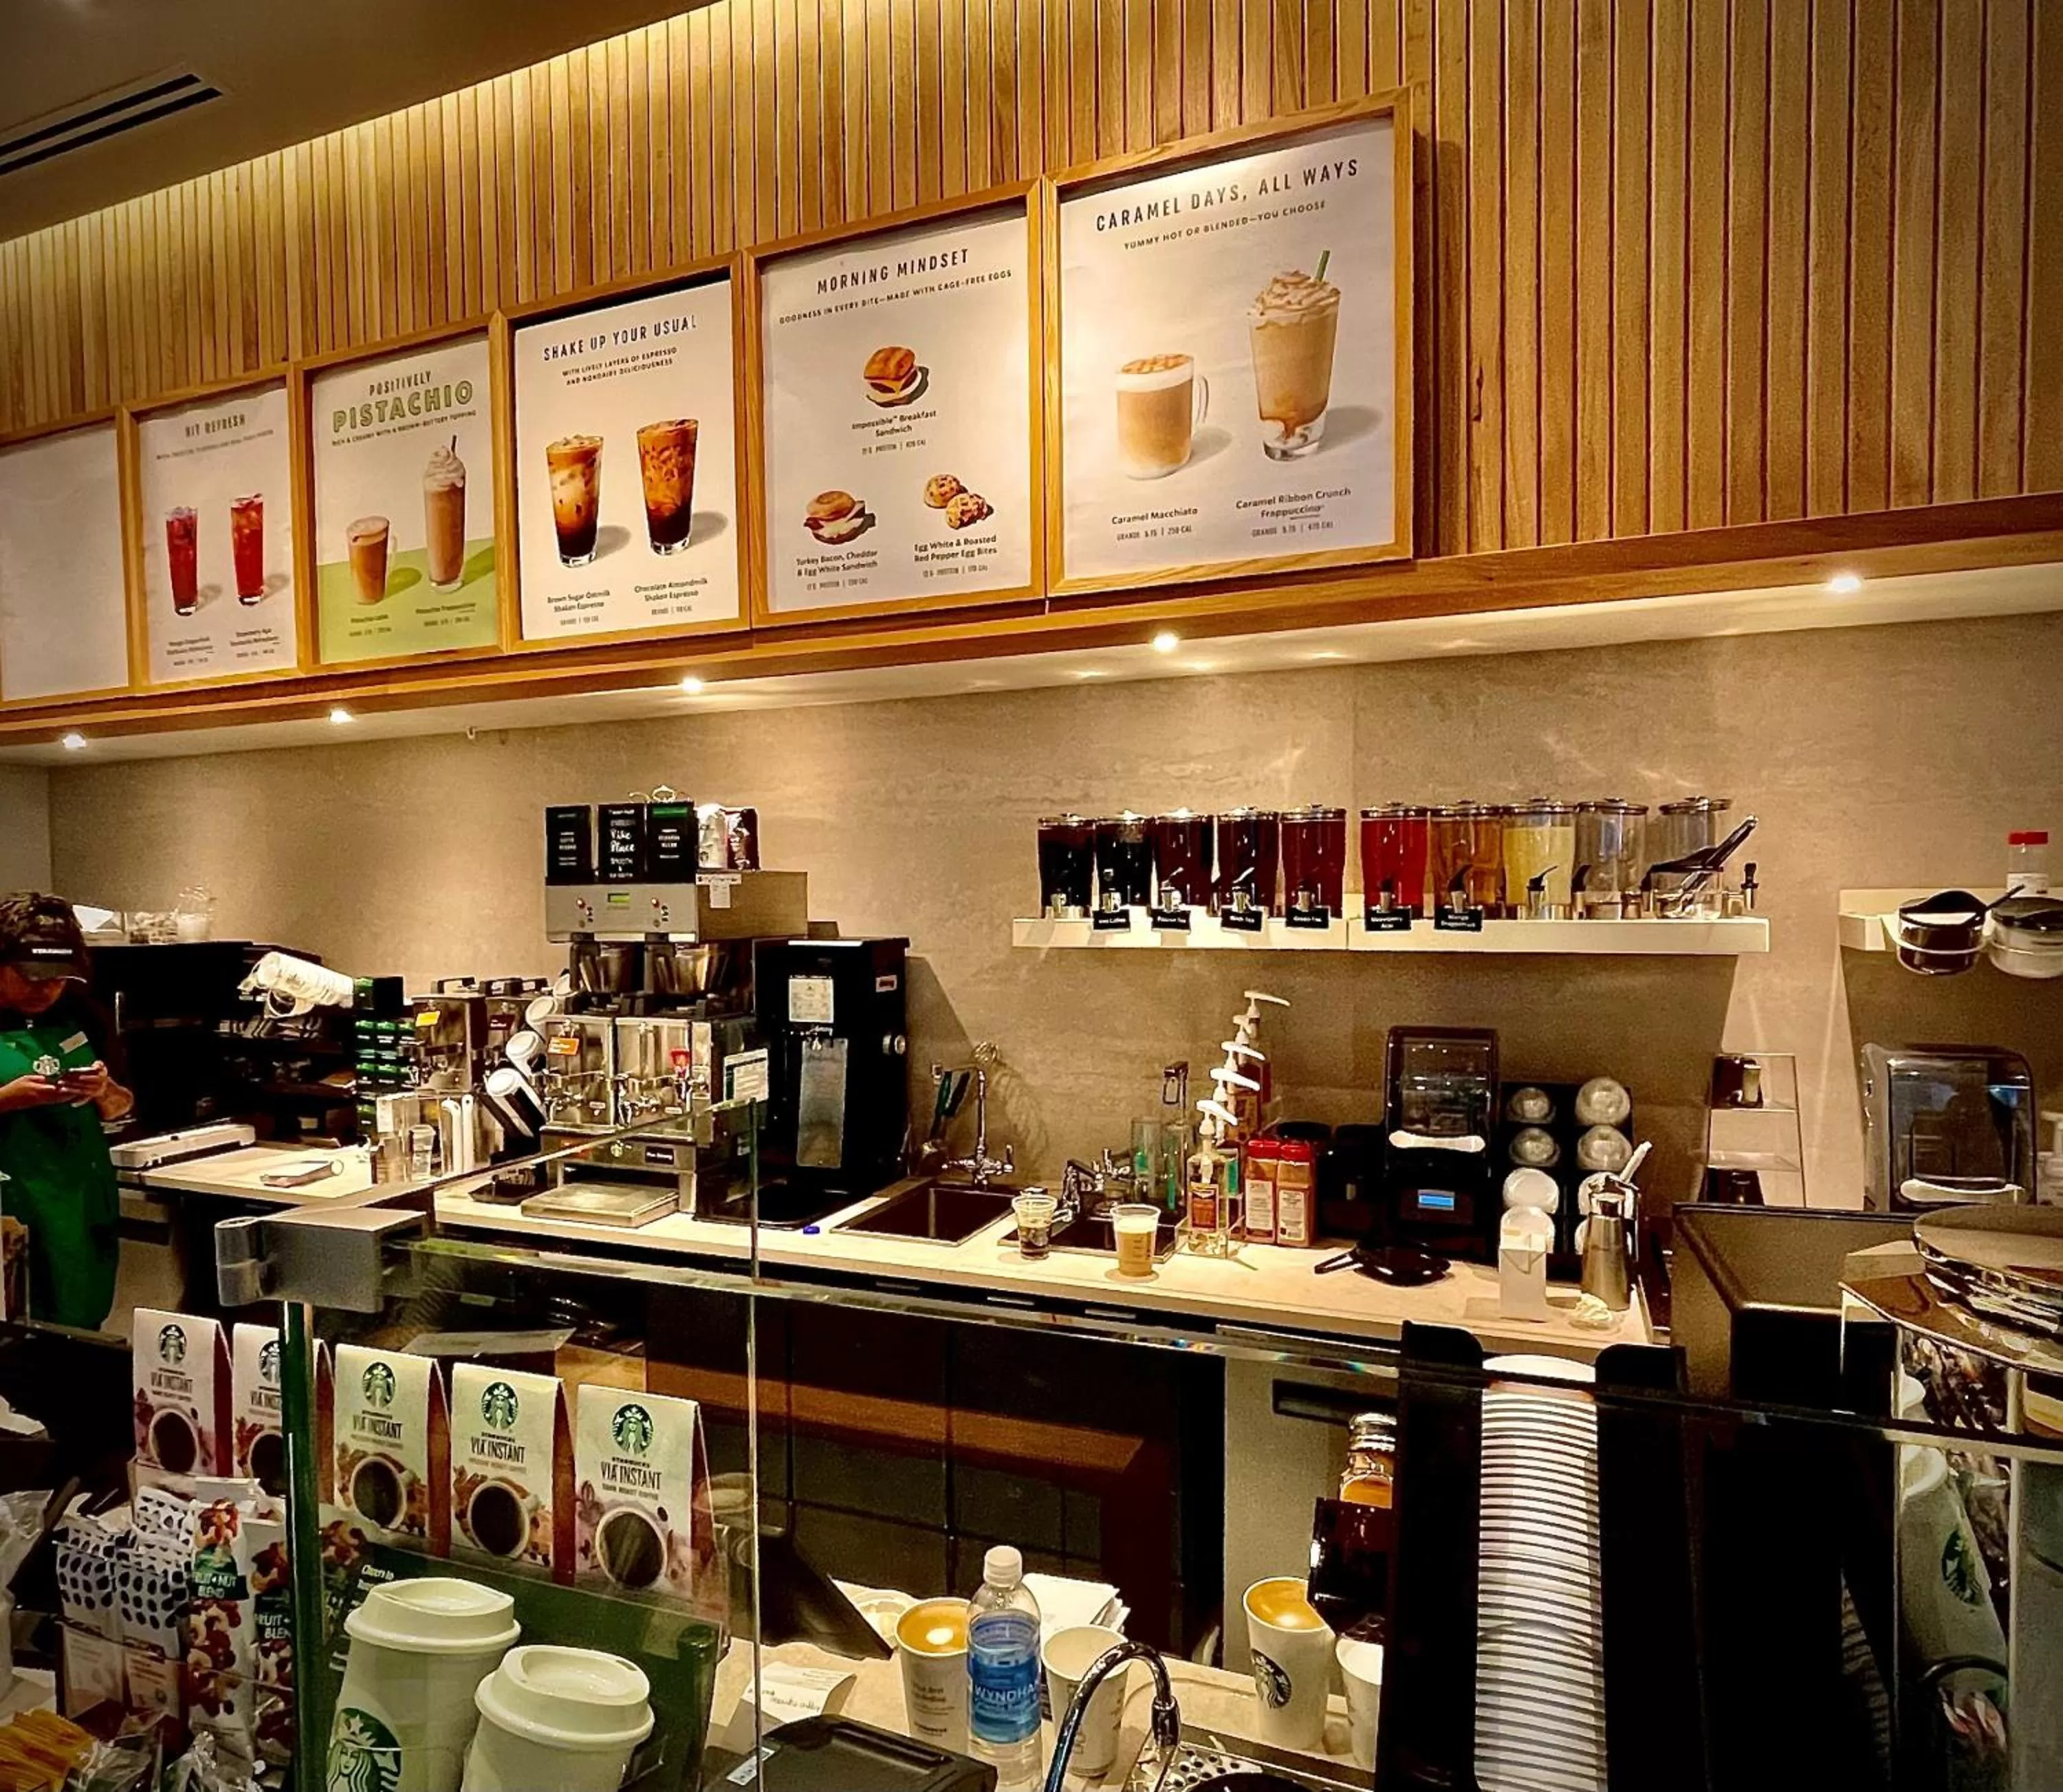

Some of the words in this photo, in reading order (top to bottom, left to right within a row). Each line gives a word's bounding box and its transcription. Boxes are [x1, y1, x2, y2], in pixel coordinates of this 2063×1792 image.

[1096, 197, 1181, 232] CARAMEL
[1191, 184, 1247, 210] DAYS,
[1259, 174, 1291, 196] ALL
[1303, 159, 1359, 186] WAYS
[1124, 237, 1160, 250] YUMMY
[1163, 230, 1183, 242] HOT
[1186, 226, 1200, 236] OR
[1282, 200, 1326, 217] CHOOSE
[817, 265, 889, 294] MORNING
[897, 248, 969, 278] MINDSET
[779, 309, 822, 325] GOODNESS
[834, 301, 859, 313] EVERY
[913, 285, 936, 297] WITH
[937, 275, 985, 292] CAGE-FREE
[988, 269, 1012, 281] EGGS
[544, 340, 584, 361] SHAKE
[590, 335, 606, 351] UP
[613, 326, 646, 345] YOUR
[654, 315, 697, 337] USUAL
[562, 367, 580, 377] WITH
[581, 363, 603, 373] LIVELY
[604, 358, 629, 369] LAYERS
[642, 347, 677, 360] ESPRESSO
[620, 358, 673, 375] DELICIOUSNESS
[369, 371, 431, 396] POSITIVELY
[333, 380, 473, 433] PISTACHIO
[899, 411, 936, 422] Breakfast
[185, 424, 200, 437] HIT
[204, 414, 245, 434] REFRESH
[875, 424, 913, 437] Sandwich
[1236, 496, 1276, 510] Caramel
[1278, 493, 1313, 506] Ribbon
[1316, 487, 1351, 500] Crunch
[1112, 513, 1149, 525] Caramel
[1151, 506, 1198, 520] Macchiato
[914, 554, 929, 562] Red
[930, 552, 959, 561] Pepper
[961, 549, 975, 558] Egg
[977, 547, 998, 556] Bites
[915, 544, 928, 553] Egg
[929, 540, 954, 549] White
[963, 535, 996, 545] Roasted
[796, 554, 819, 567] Turkey
[847, 550, 878, 560] Cheddar
[805, 567, 817, 576] Egg
[817, 565, 840, 573] White
[842, 560, 878, 571] Sandwich
[610, 840, 635, 853] Place
[471, 1436, 485, 1456] VIA
[487, 1439, 526, 1464] INSTANT
[600, 1461, 618, 1480] VIA
[619, 1465, 662, 1490] INSTANT
[218, 1574, 237, 1587] NUT
[198, 1585, 225, 1599] BLEND
[975, 1683, 1038, 1703] WYNDHA
